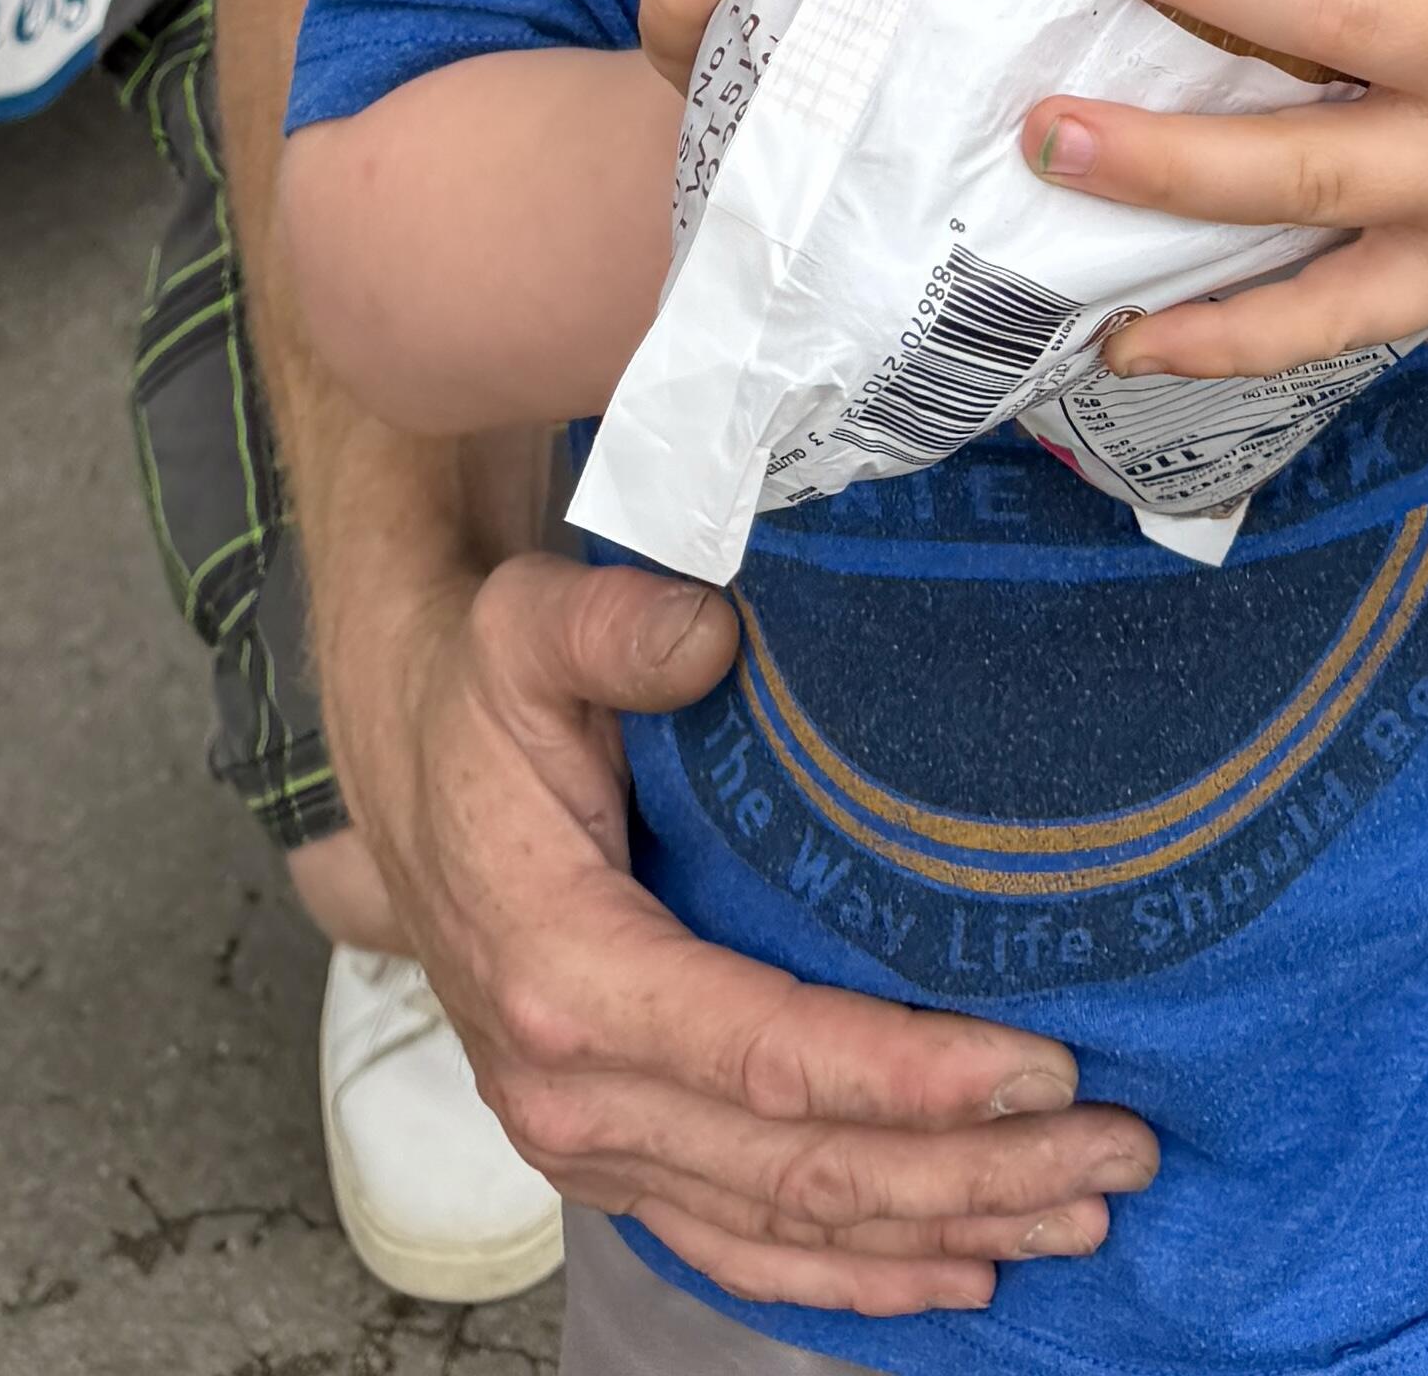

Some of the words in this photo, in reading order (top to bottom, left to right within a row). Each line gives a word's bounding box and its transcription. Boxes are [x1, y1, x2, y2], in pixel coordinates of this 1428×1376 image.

[692, 37, 733, 108] No.
[718, 79, 743, 106] 5
[949, 217, 966, 234] 8
[900, 265, 952, 350] 88670
[840, 355, 905, 420] 21012
[761, 446, 807, 477] GLUTE
[704, 694, 774, 840] The
[787, 825, 917, 958] Way
[948, 907, 1094, 973] Life
[1130, 770, 1355, 950] Should
